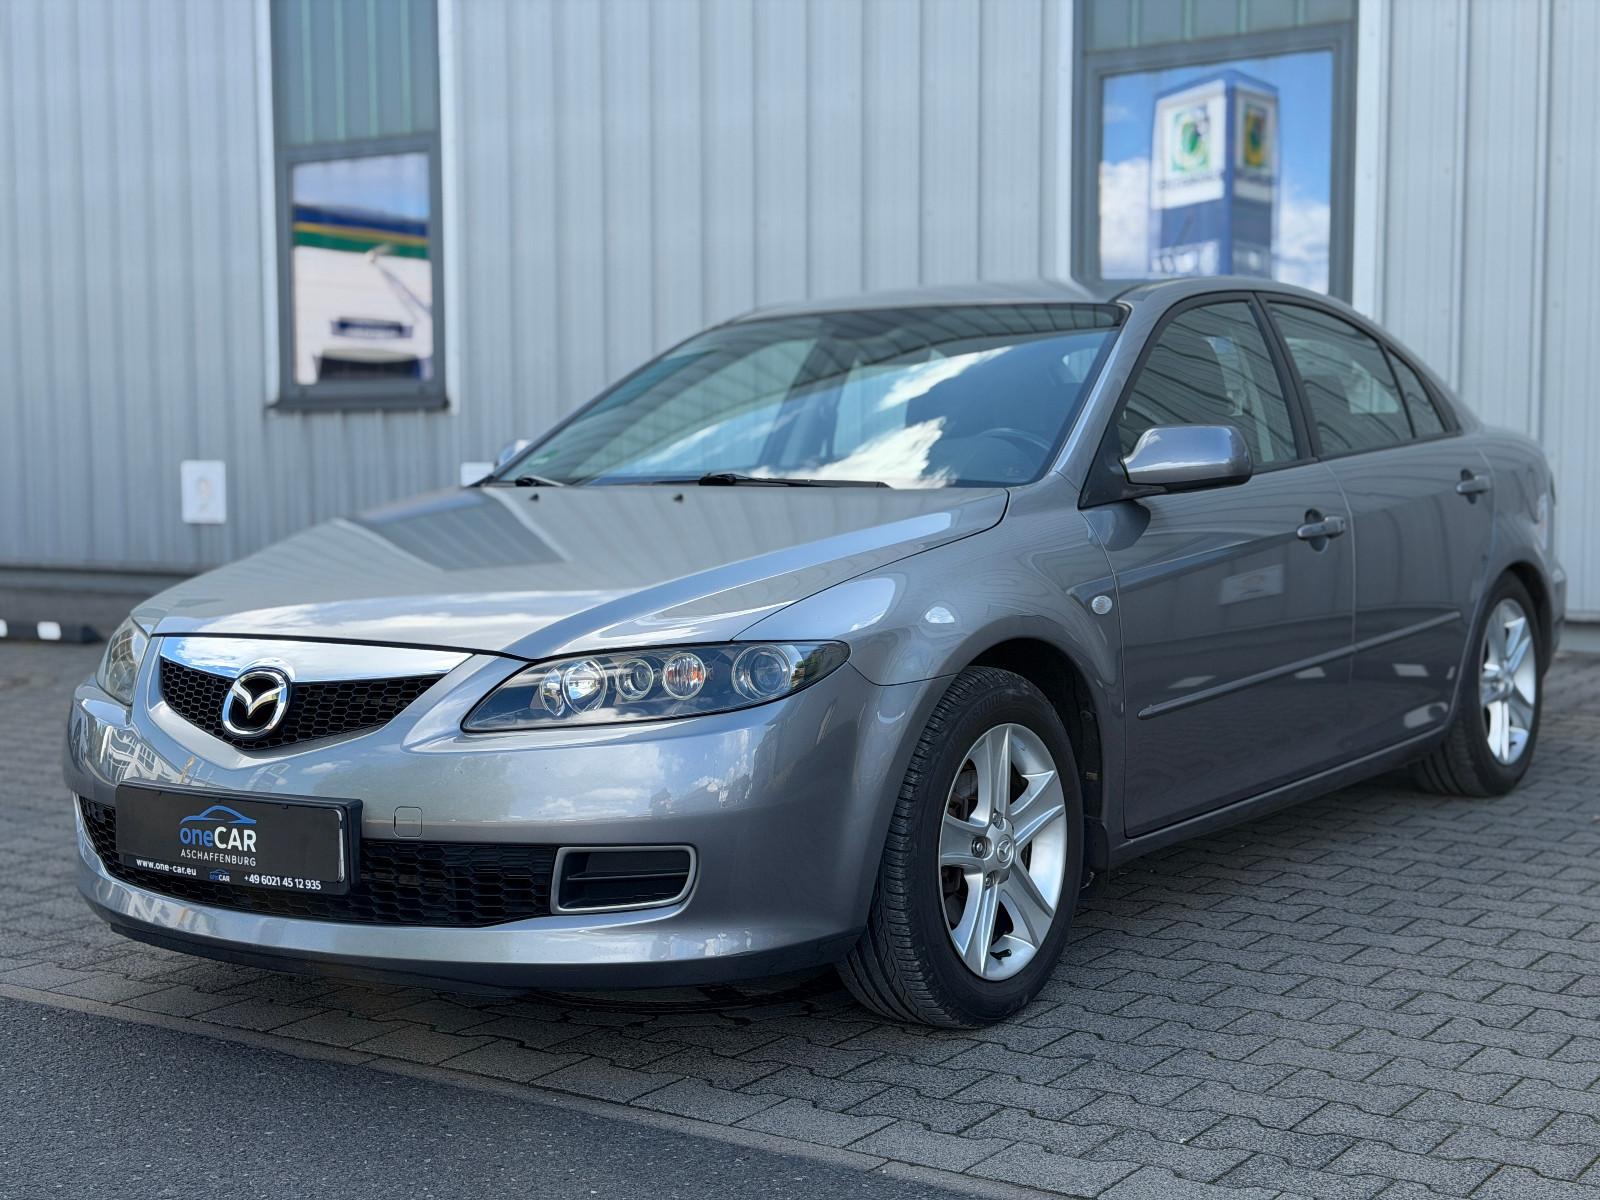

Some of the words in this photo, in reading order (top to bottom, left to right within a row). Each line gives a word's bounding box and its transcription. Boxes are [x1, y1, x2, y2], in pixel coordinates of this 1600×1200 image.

[180, 826, 257, 852] oneCAR
[136, 857, 197, 876] www.one-car.eu
[180, 849, 256, 867] ASCHAFFENBURG
[244, 874, 260, 885] +49
[261, 875, 281, 888] 6021
[282, 878, 294, 889] 45
[295, 879, 304, 890] 12
[305, 880, 322, 890] 935
